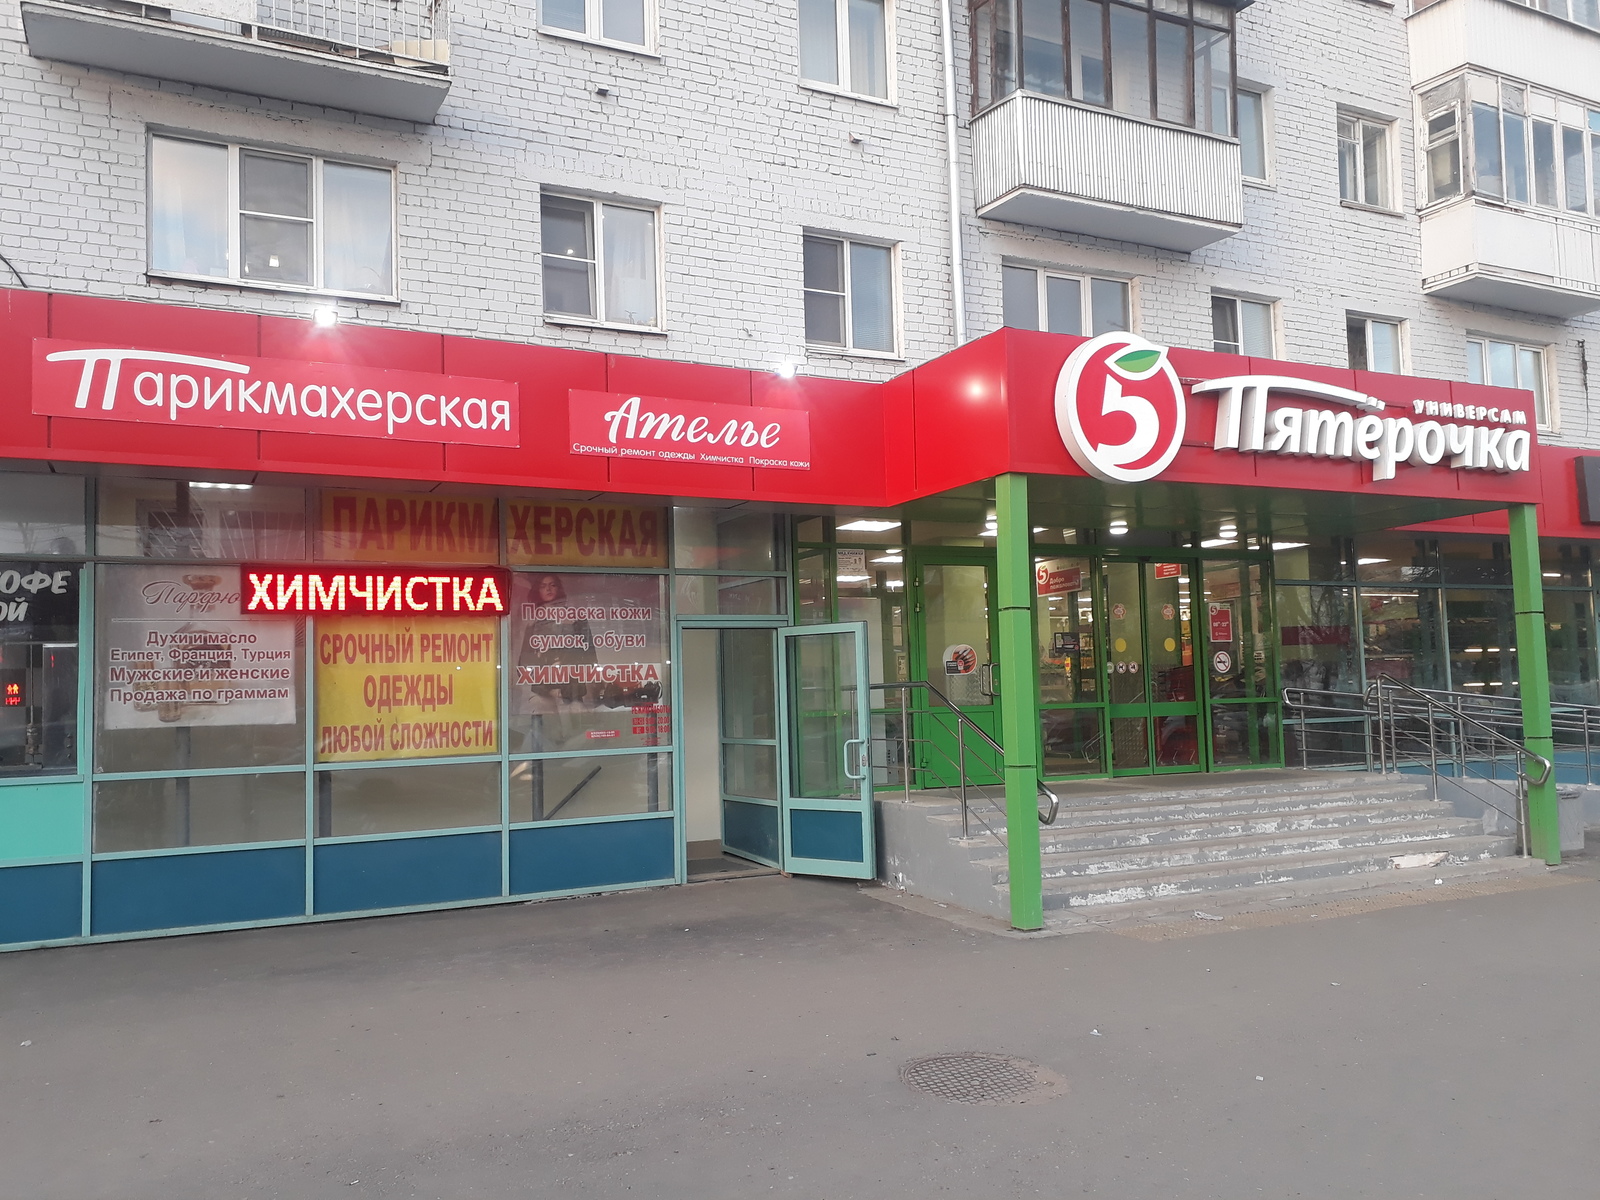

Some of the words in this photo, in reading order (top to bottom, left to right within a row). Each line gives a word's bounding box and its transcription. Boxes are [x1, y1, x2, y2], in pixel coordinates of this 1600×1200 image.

[46, 348, 512, 434] Парикмахерская
[604, 396, 781, 448] Ателье
[1413, 399, 1527, 425] УНИВЕРСАМ
[1191, 375, 1531, 482] Пятёрочка
[573, 442, 618, 454] Срочный
[620, 447, 656, 459] ремонт
[658, 450, 696, 461] одежды
[700, 453, 744, 464] Химчистка
[749, 456, 788, 467] Покраска
[789, 460, 810, 468] кожи
[0, 570, 72, 594] ОФЕ
[247, 573, 504, 612] ХИМЧИСТКА
[142, 580, 241, 614] Парфю
[521, 602, 606, 622] Покраска
[610, 606, 652, 621] кожи
[147, 631, 190, 647] Духи
[193, 635, 204, 645] и
[206, 634, 258, 645] масло
[319, 626, 414, 665] СРОЧНЫЙ
[420, 633, 494, 663] РЕМОНТ
[529, 634, 589, 652] сумок,
[592, 631, 646, 650] обуви
[110, 649, 165, 663] Египет,
[169, 648, 237, 663] Франция,
[242, 648, 291, 661] Турция
[110, 667, 194, 683] Мужские
[199, 668, 211, 680] и
[215, 667, 291, 680] женские
[515, 663, 660, 685] ХИМЧИСТКА
[110, 688, 187, 704] Продажа
[192, 689, 213, 701] по
[217, 688, 289, 702] граммам
[363, 674, 454, 714] ОДЕЖДЫ
[320, 717, 386, 754] ЛЮБОЙ
[390, 720, 494, 751] СЛОЖНОСТИ
